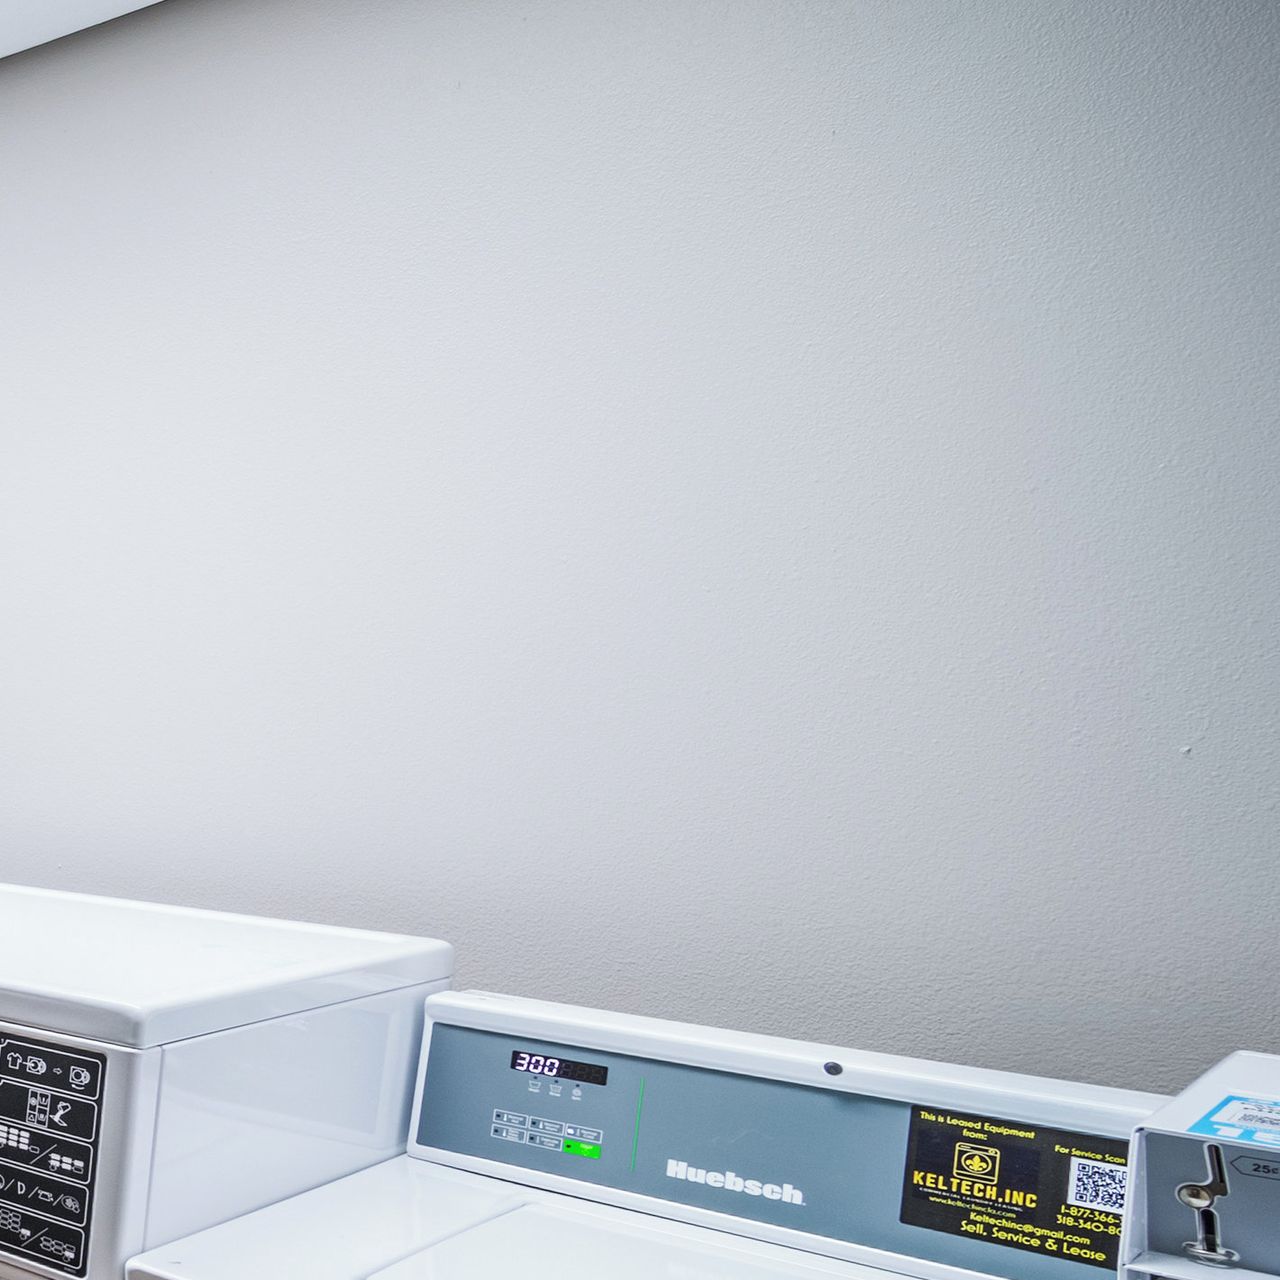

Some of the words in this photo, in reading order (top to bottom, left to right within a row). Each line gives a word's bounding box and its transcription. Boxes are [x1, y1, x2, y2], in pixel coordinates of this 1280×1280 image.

[920, 1111, 936, 1122] This
[937, 1114, 944, 1123] is
[946, 1116, 981, 1130] Leased
[984, 1122, 1035, 1139] Equipment
[962, 1128, 988, 1140] from:
[1054, 1145, 1070, 1154] For
[1071, 1148, 1103, 1159] Service
[1105, 1154, 1126, 1164] Scan
[666, 1158, 803, 1205] Huebsch
[970, 1211, 1091, 1245] Keltechinc@gmail.com
[1061, 1205, 1122, 1224] 1-877-366-
[991, 1227, 1041, 1247] Service
[1045, 1238, 1058, 1251] &
[1063, 1242, 1106, 1261] Lease
